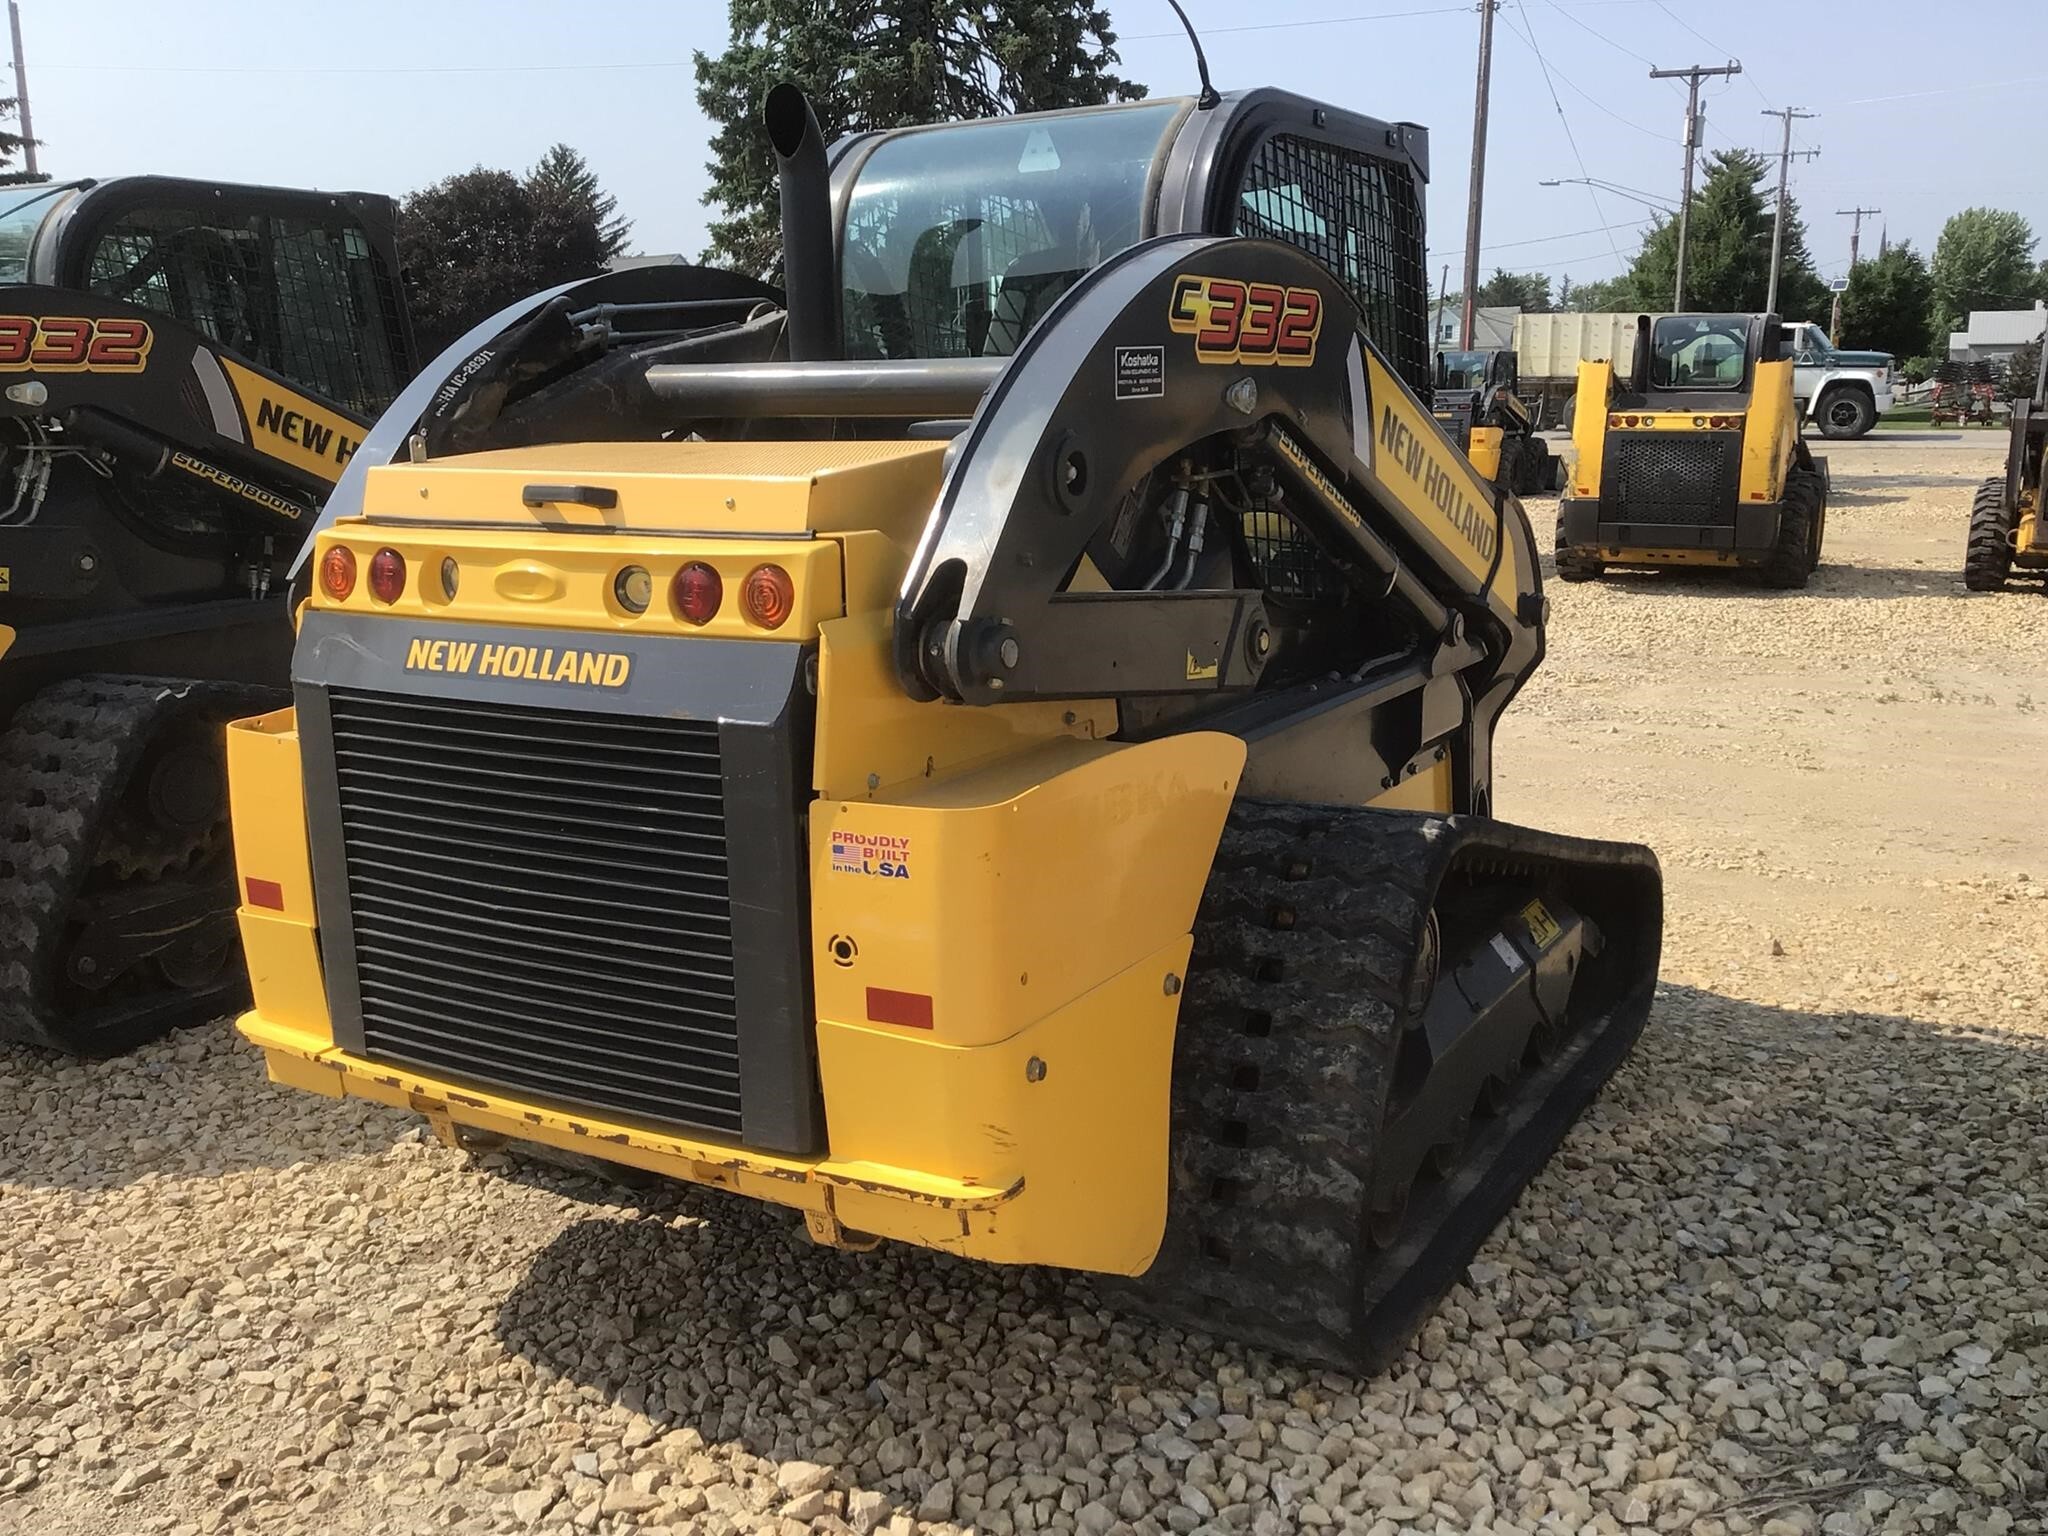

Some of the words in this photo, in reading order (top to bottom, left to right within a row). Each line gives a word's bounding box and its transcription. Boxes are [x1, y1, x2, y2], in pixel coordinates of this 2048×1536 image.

[1169, 276, 1322, 366] C332
[256, 398, 334, 456] NEW
[1380, 404, 1426, 483] NEW
[1423, 455, 1494, 563] HOLLAND
[406, 639, 477, 673] NEW
[478, 644, 630, 688] HOLLAND
[832, 831, 909, 849] PROUDLY
[863, 847, 910, 862] BUILT
[832, 863, 842, 872] in
[844, 864, 862, 874] the
